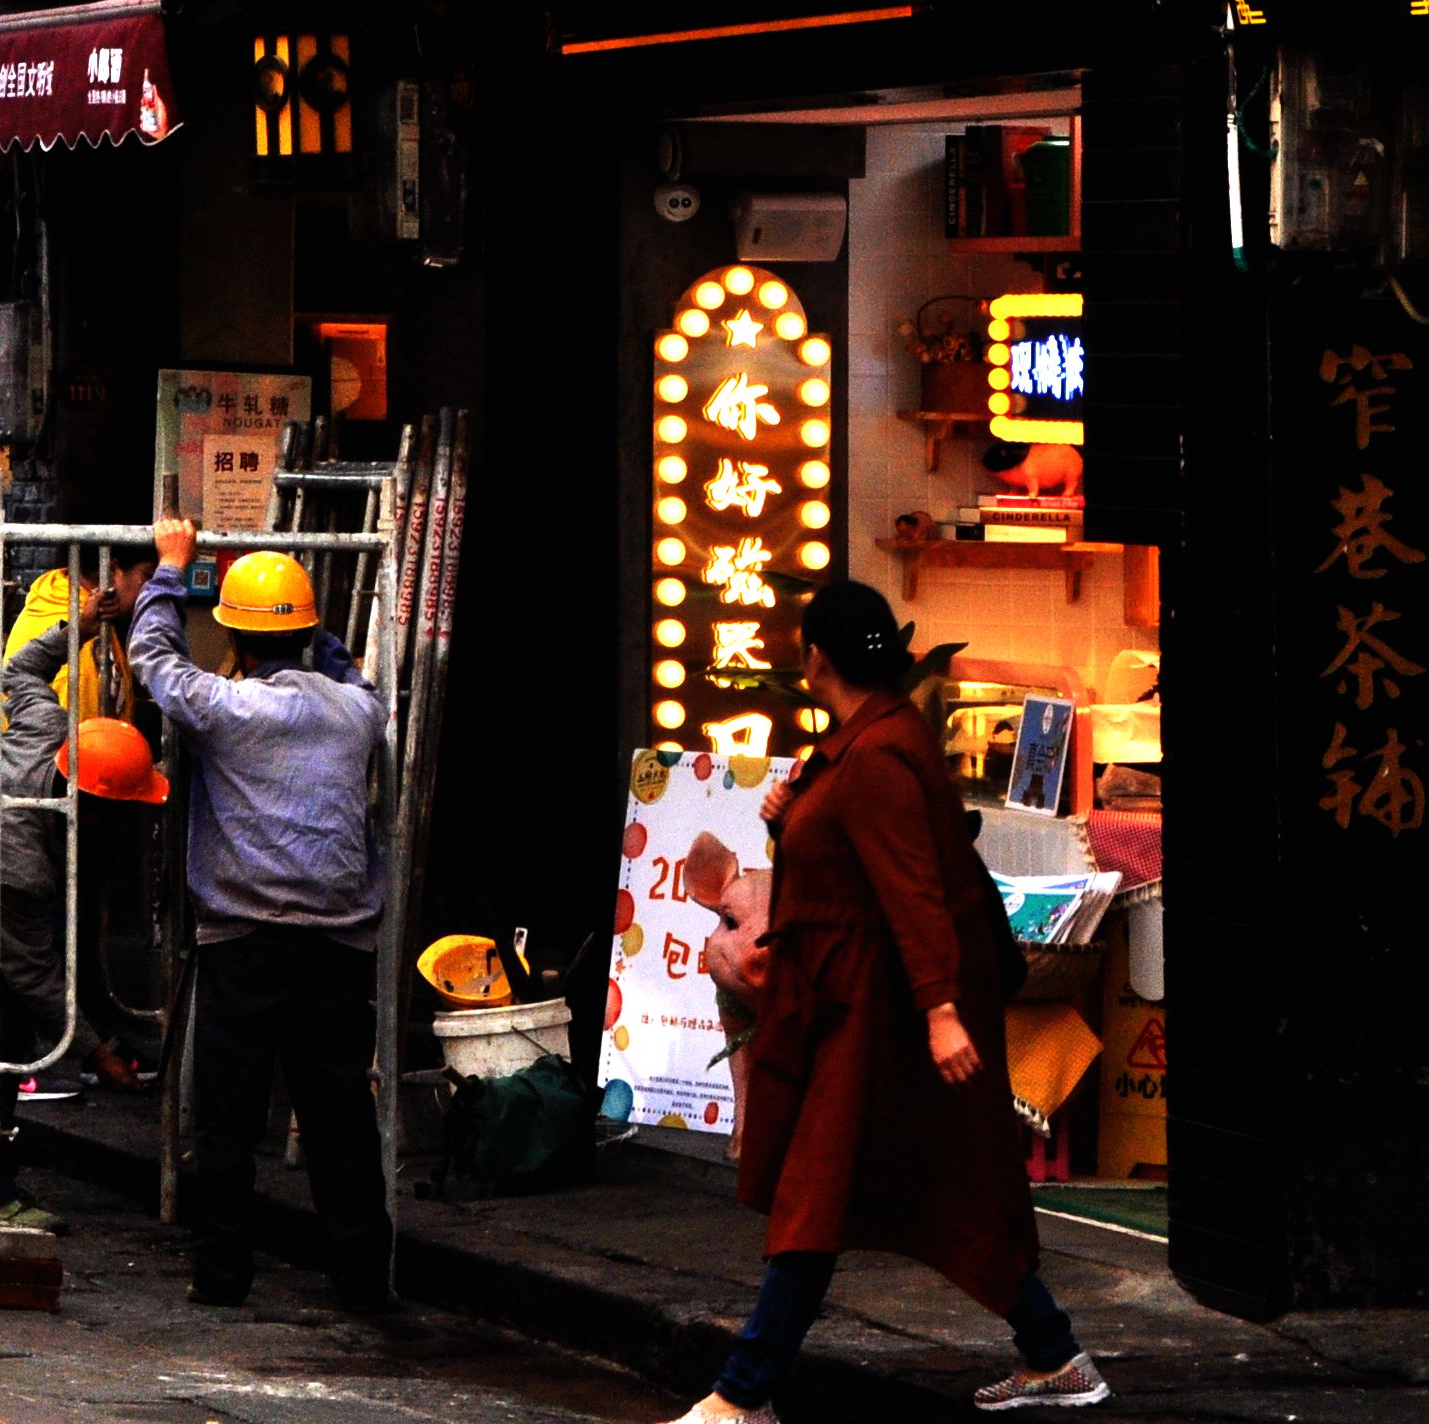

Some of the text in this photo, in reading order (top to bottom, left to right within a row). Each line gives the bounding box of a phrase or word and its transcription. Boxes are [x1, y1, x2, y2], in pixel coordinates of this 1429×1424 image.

[222, 417, 282, 429] NOUGAT
[214, 451, 260, 473] 招聘
[992, 510, 1071, 524] CINDERELLA
[1315, 343, 1427, 838] 窄巷茶铺
